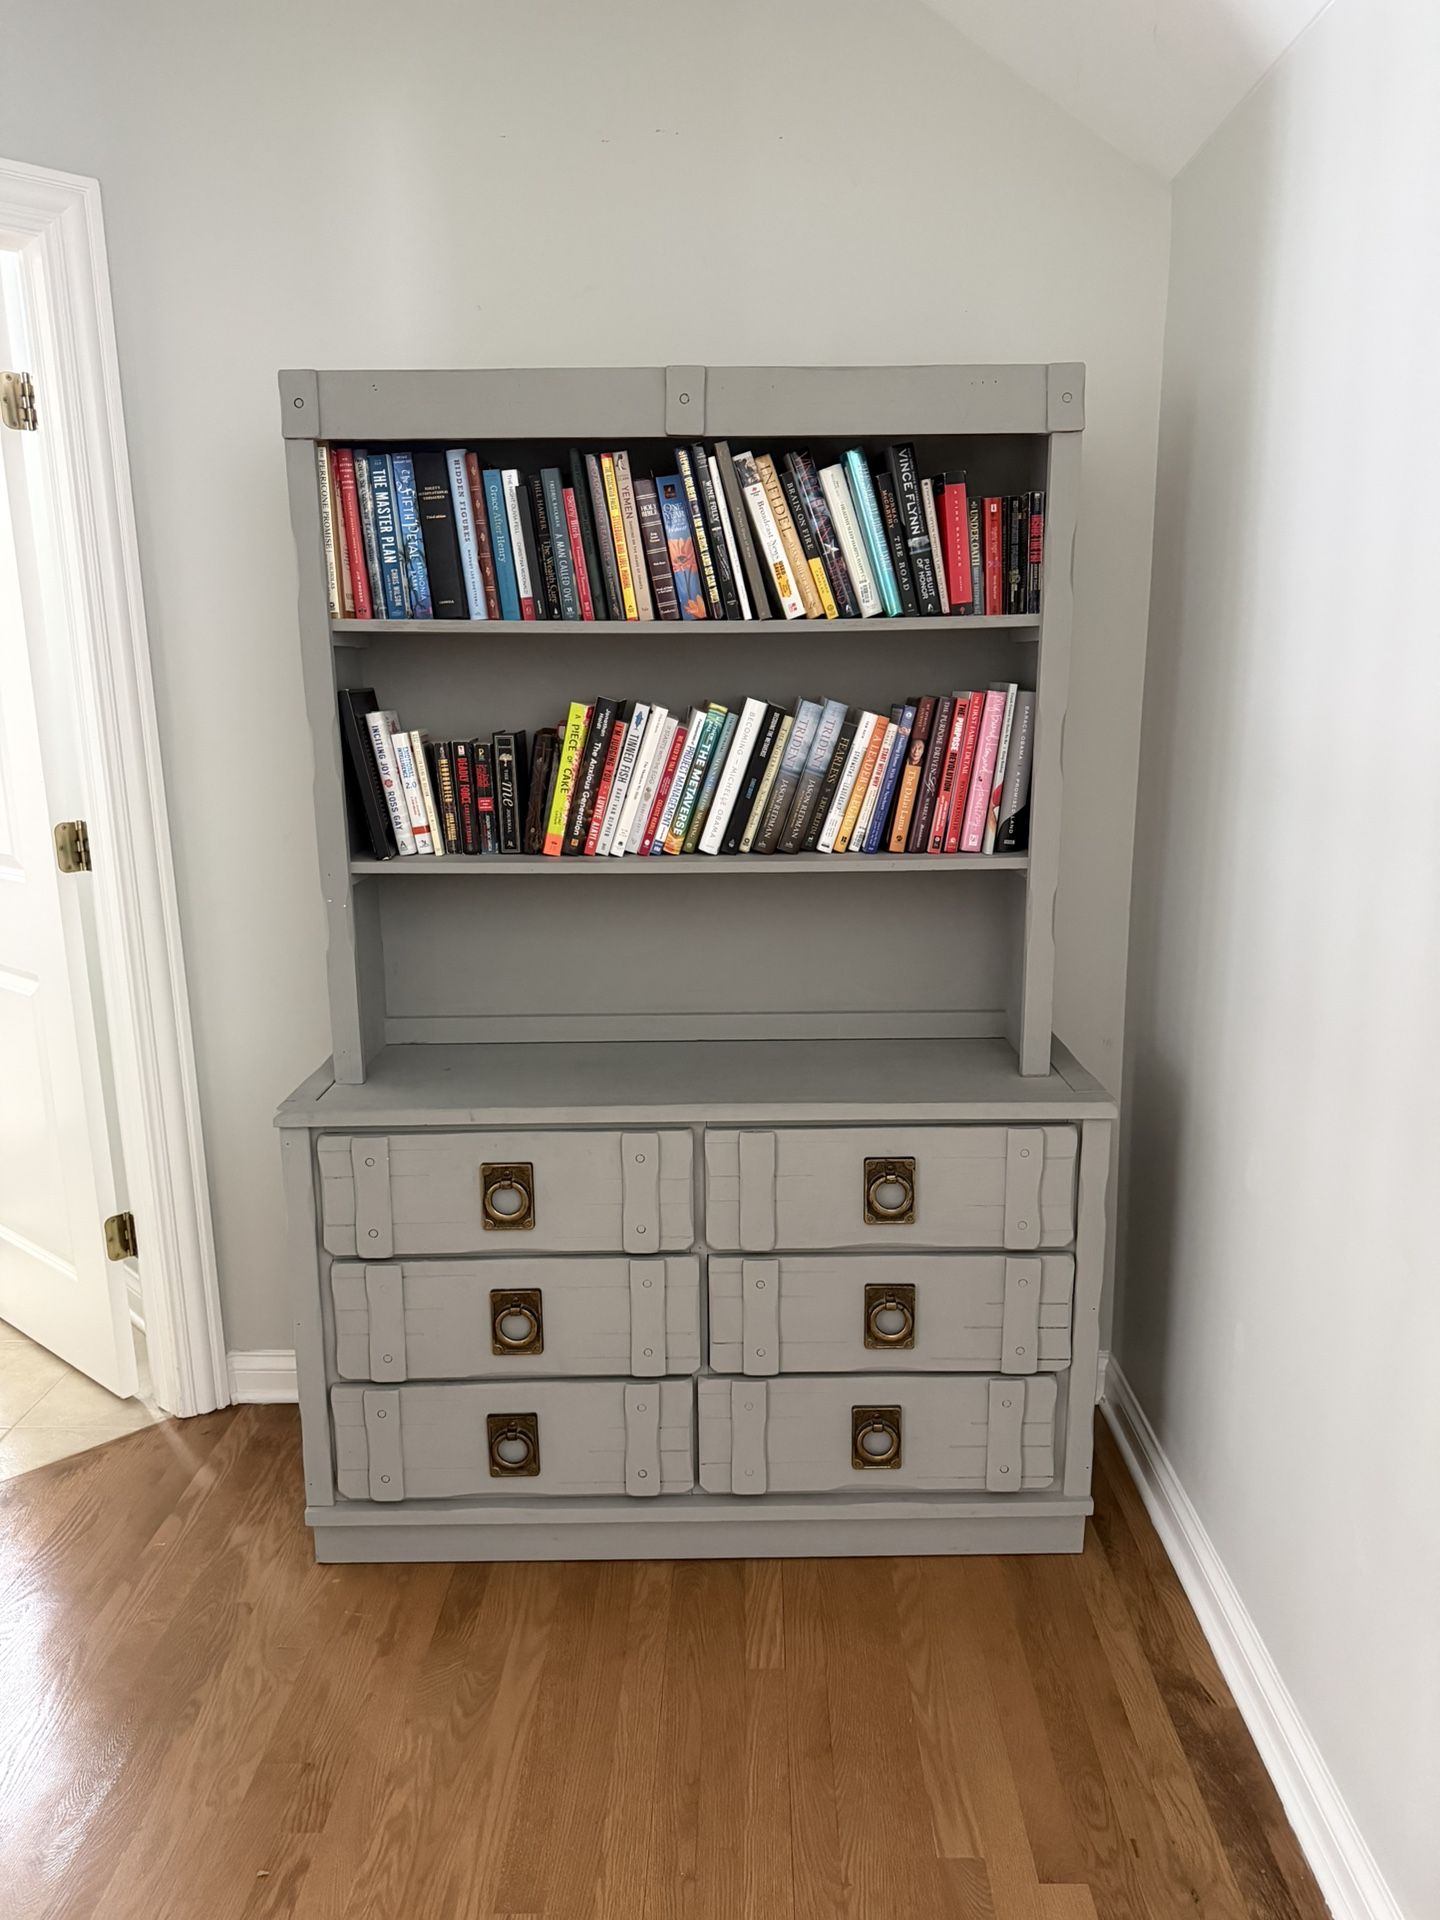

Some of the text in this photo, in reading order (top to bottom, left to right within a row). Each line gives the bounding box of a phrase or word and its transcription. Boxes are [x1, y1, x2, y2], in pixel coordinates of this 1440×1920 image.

[373, 469, 386, 488] THE
[678, 451, 698, 501] STEPHEN COLBERT
[706, 480, 716, 500] WINE
[898, 449, 921, 535] VINCE FLYNN
[319, 460, 332, 548] PERRICONE PROMISE
[375, 492, 392, 532] MASTER
[454, 460, 470, 543] HIDDEN FIGURES
[534, 480, 547, 530] HILL HARPER
[622, 486, 633, 519] YEMEN
[709, 501, 719, 522] FOLLY
[761, 465, 792, 538] INFIDEL
[787, 483, 814, 550] BRAIN ON FIRE
[881, 490, 894, 528] McCARTHY
[888, 493, 898, 523] CORMAC
[489, 485, 506, 563] Grace After Henry
[570, 519, 578, 539] Bitch
[757, 501, 780, 560] Broadcast News
[970, 510, 980, 565] UNDER OATH
[381, 537, 397, 563] PLAN
[543, 540, 552, 556] The
[556, 542, 566, 559] MAN
[613, 515, 631, 589] STYLEBOOK AND LIBEL MANUAL
[695, 528, 708, 551] AMERICA
[706, 577, 715, 588] CAN
[894, 536, 910, 590] THE ROAD
[391, 569, 402, 606] CHRIS WILSON
[544, 559, 555, 584] Wealth
[559, 560, 570, 585] CALLED
[916, 559, 929, 599] OF HONOR
[924, 559, 935, 597] PURSUIT
[550, 585, 558, 603] Cure
[564, 588, 572, 602] OVE
[595, 713, 604, 729] Haidt
[987, 693, 1004, 712] My
[1022, 706, 1030, 733] BARACK
[568, 724, 580, 751] PIECE
[600, 709, 611, 736] Jonathan
[778, 728, 788, 741] THE
[930, 702, 950, 772] THE PURPOSE DRIVEN
[962, 705, 979, 775] FIRST FAMILY DETAIL
[371, 725, 390, 776] INCITING JOY
[397, 748, 408, 779] INTELLIGENCE
[603, 725, 622, 783] I'M JUDGING YOU
[618, 734, 639, 783] TINNED FISH
[679, 745, 695, 775] PROJECT
[765, 744, 783, 782] NOTEBOOK
[786, 720, 810, 768] TRIDENT
[812, 720, 836, 768] TRIDENT
[827, 738, 849, 784] FEARLESS
[943, 704, 966, 792] THE PURPOSE REVOLUTION
[457, 758, 471, 804] DEADLY FORCE
[560, 768, 573, 793] CAKE
[649, 770, 658, 784] EGG
[668, 761, 677, 771] TALK
[709, 711, 756, 838] BECOMING MICHELLE OBAMA
[847, 751, 861, 777] STRENGTHS
[855, 744, 878, 791] LEADER'S
[872, 747, 888, 787] START WITH WHY
[501, 782, 514, 807] me
[573, 742, 601, 835] The Anxious Generation
[662, 776, 686, 827] MANAGEMENT
[673, 744, 711, 836] THE METAVERSE
[773, 779, 789, 804] JASON
[897, 770, 917, 831] The Dalai Lama
[1011, 778, 1020, 813] PROMISED
[387, 791, 403, 831] ROSS GAY
[589, 796, 606, 840] LUVVIE AJAYI
[611, 804, 619, 814] VAN
[764, 805, 781, 839] REDMAN
[791, 779, 816, 839] JASON REDMAN
[843, 793, 863, 832] LEGACY
[922, 798, 930, 820] WARREN
